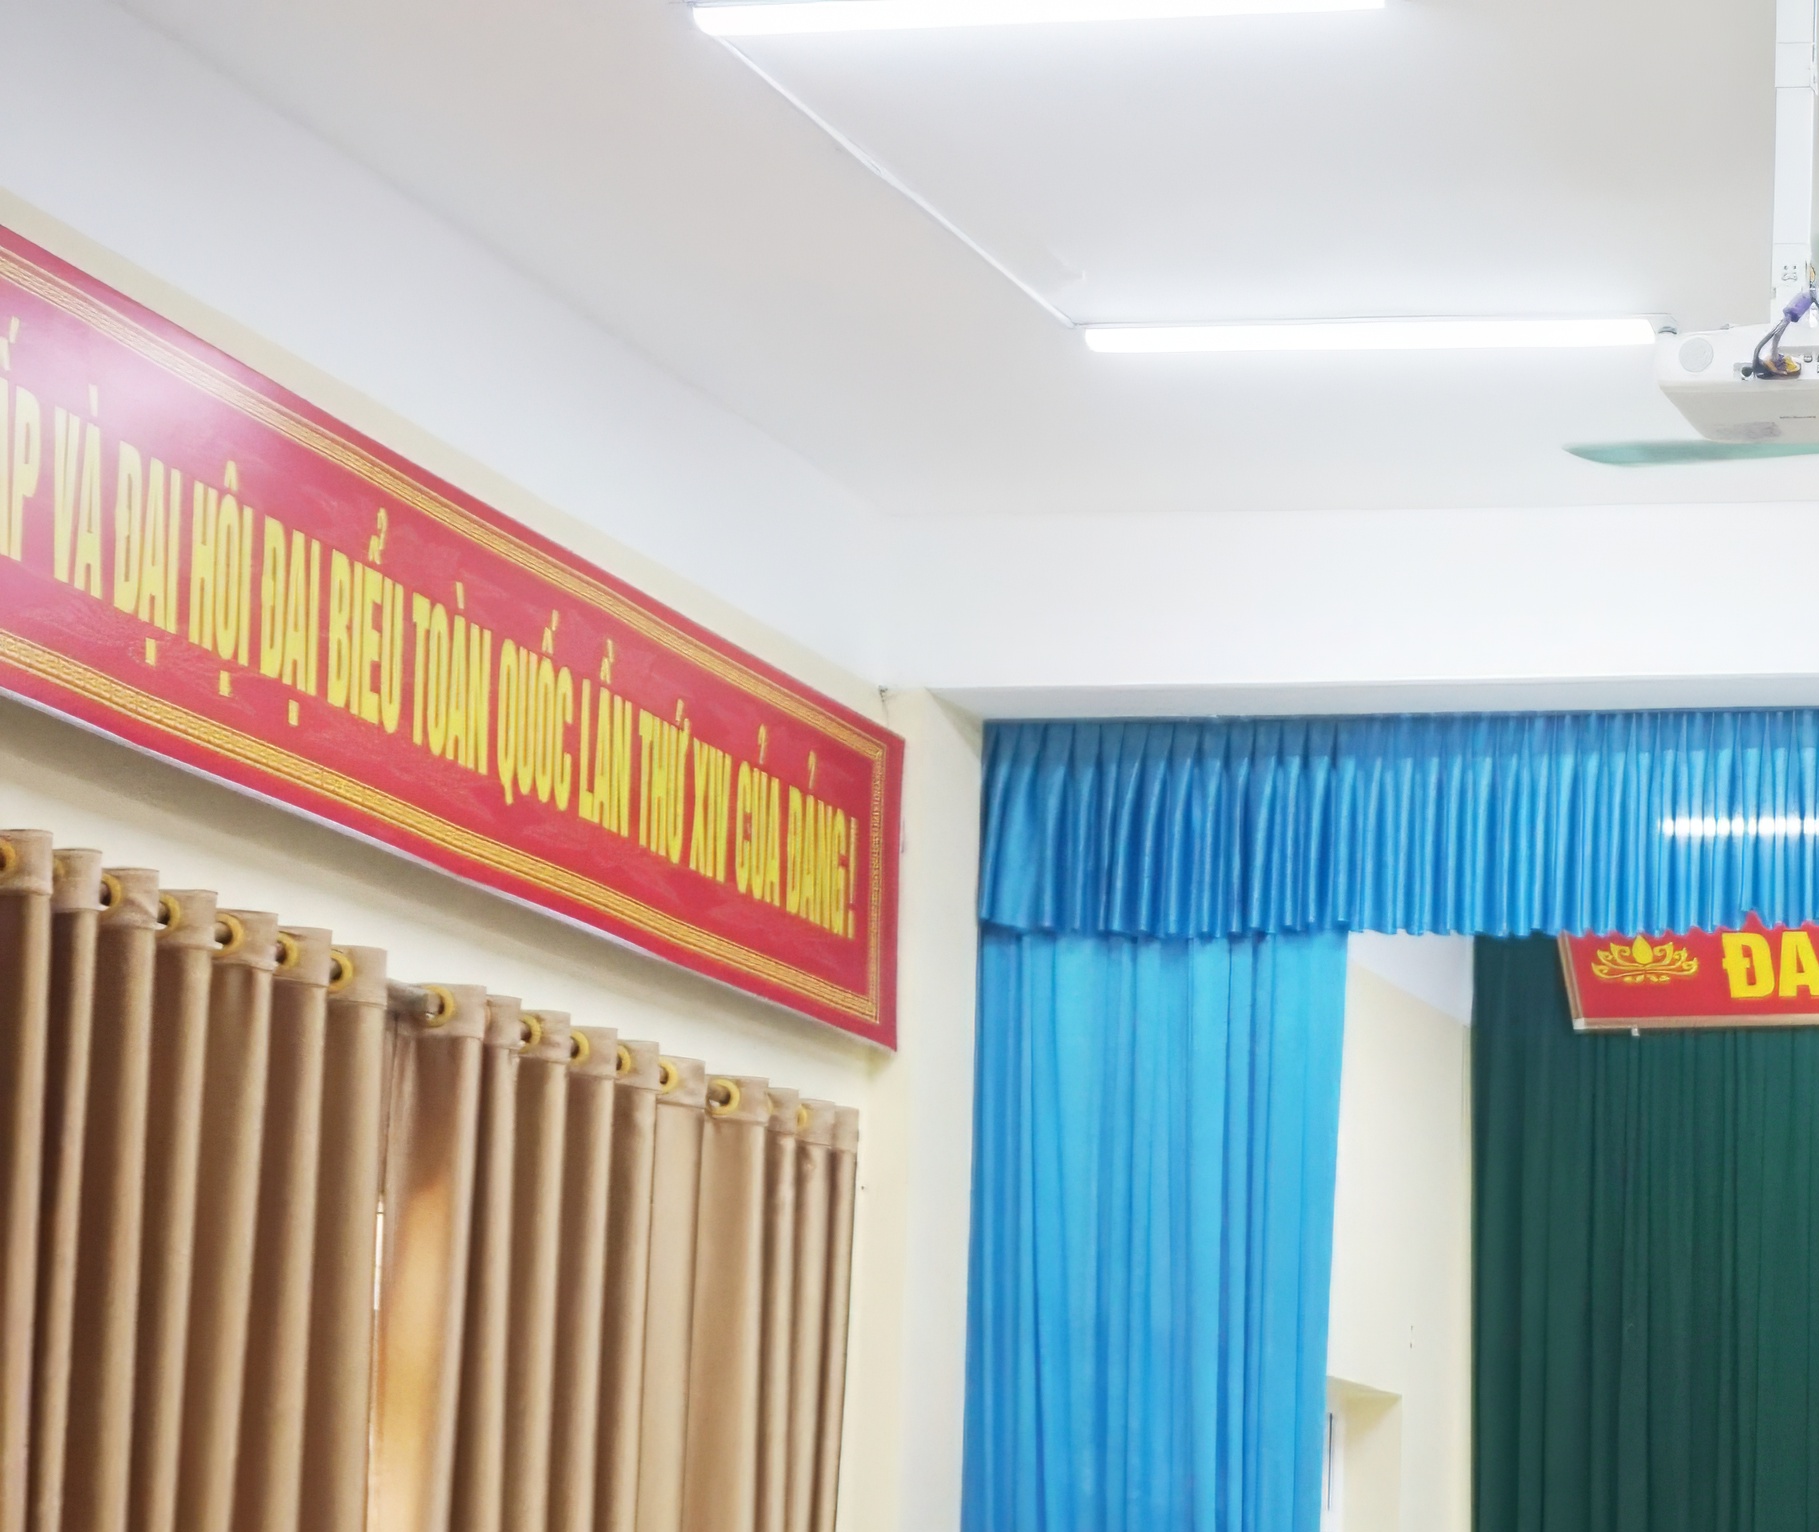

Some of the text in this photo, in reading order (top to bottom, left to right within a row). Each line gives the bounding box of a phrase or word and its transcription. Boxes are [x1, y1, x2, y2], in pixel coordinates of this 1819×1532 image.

[54, 383, 103, 600] VÀ
[113, 440, 182, 667] ĐẠI
[188, 460, 254, 697] HỘI
[260, 514, 320, 726] ĐẠI
[327, 507, 404, 734] BIỂU
[412, 582, 492, 776] TOÀN
[497, 609, 574, 812] QUỐC
[578, 638, 632, 838] LẦN
[638, 698, 690, 865] THỨ
[688, 737, 732, 884] XIV
[735, 723, 780, 908] CỦA
[786, 750, 858, 940] ĐẢNG!
